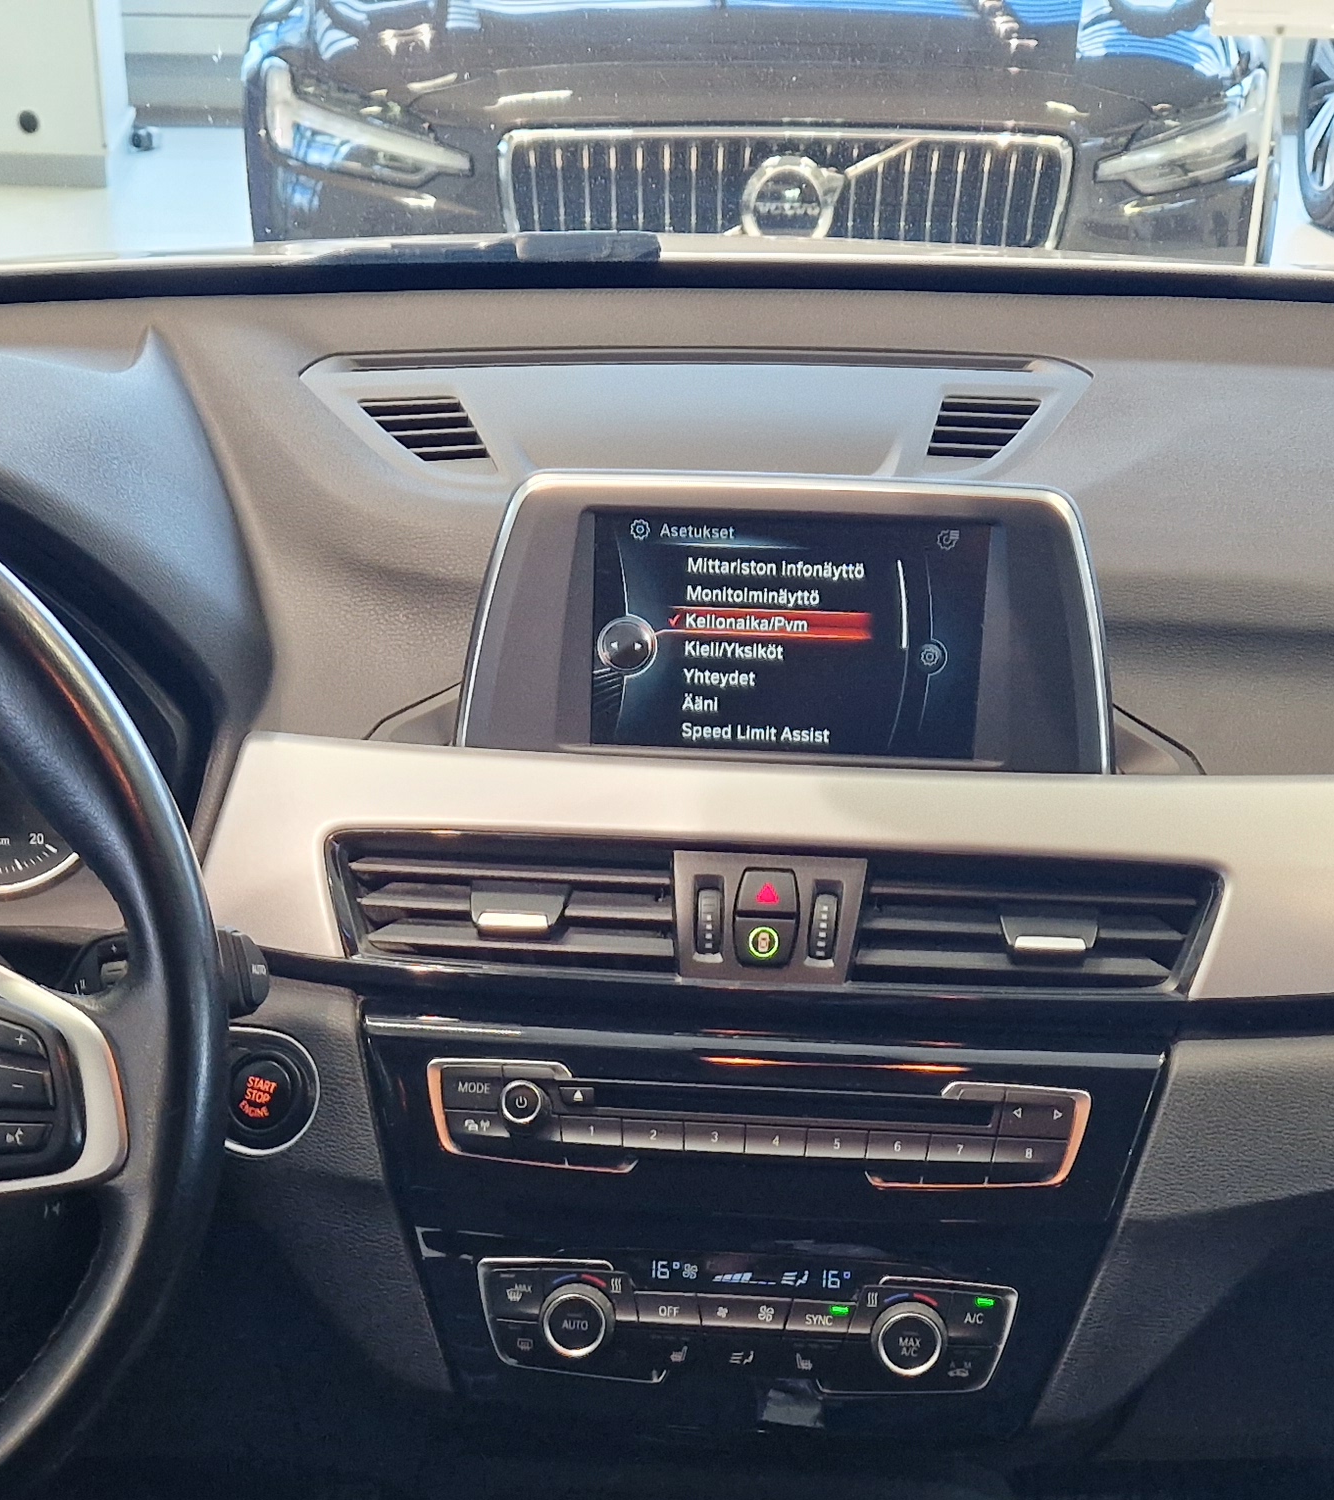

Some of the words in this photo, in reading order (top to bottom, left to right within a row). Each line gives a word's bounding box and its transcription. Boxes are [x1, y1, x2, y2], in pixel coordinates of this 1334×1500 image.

[659, 523, 735, 540] Asetukset
[687, 557, 776, 577] Mittariston
[781, 559, 865, 581] infonäyttö
[686, 585, 820, 607] Monitoiminäyttö
[685, 613, 808, 633] Kellonaika/Pvm
[684, 641, 784, 661] Kieli/Yksiköt
[683, 668, 756, 689] Yhteydet
[682, 693, 718, 712] Ääni
[681, 722, 731, 742] Speed
[736, 723, 776, 742] Limit
[780, 726, 830, 744] Assist
[29, 833, 44, 845] 20
[246, 1076, 278, 1094] START
[457, 1081, 491, 1094] MODE
[244, 1088, 272, 1104] STOP
[239, 1100, 269, 1118] ENGINE
[589, 1125, 595, 1137] 1
[649, 1129, 658, 1141] 2
[710, 1131, 719, 1142] 3
[772, 1135, 780, 1147] 4
[833, 1138, 840, 1150] 5
[893, 1141, 902, 1153] 6
[956, 1143, 964, 1155] 7
[1025, 1147, 1033, 1159] 8
[658, 1305, 680, 1317] OFF
[805, 1314, 833, 1327] SYNC
[964, 1313, 984, 1325] A/C
[562, 1320, 589, 1331] AUTO
[899, 1337, 921, 1348] MAX
[901, 1347, 919, 1357] A/C
